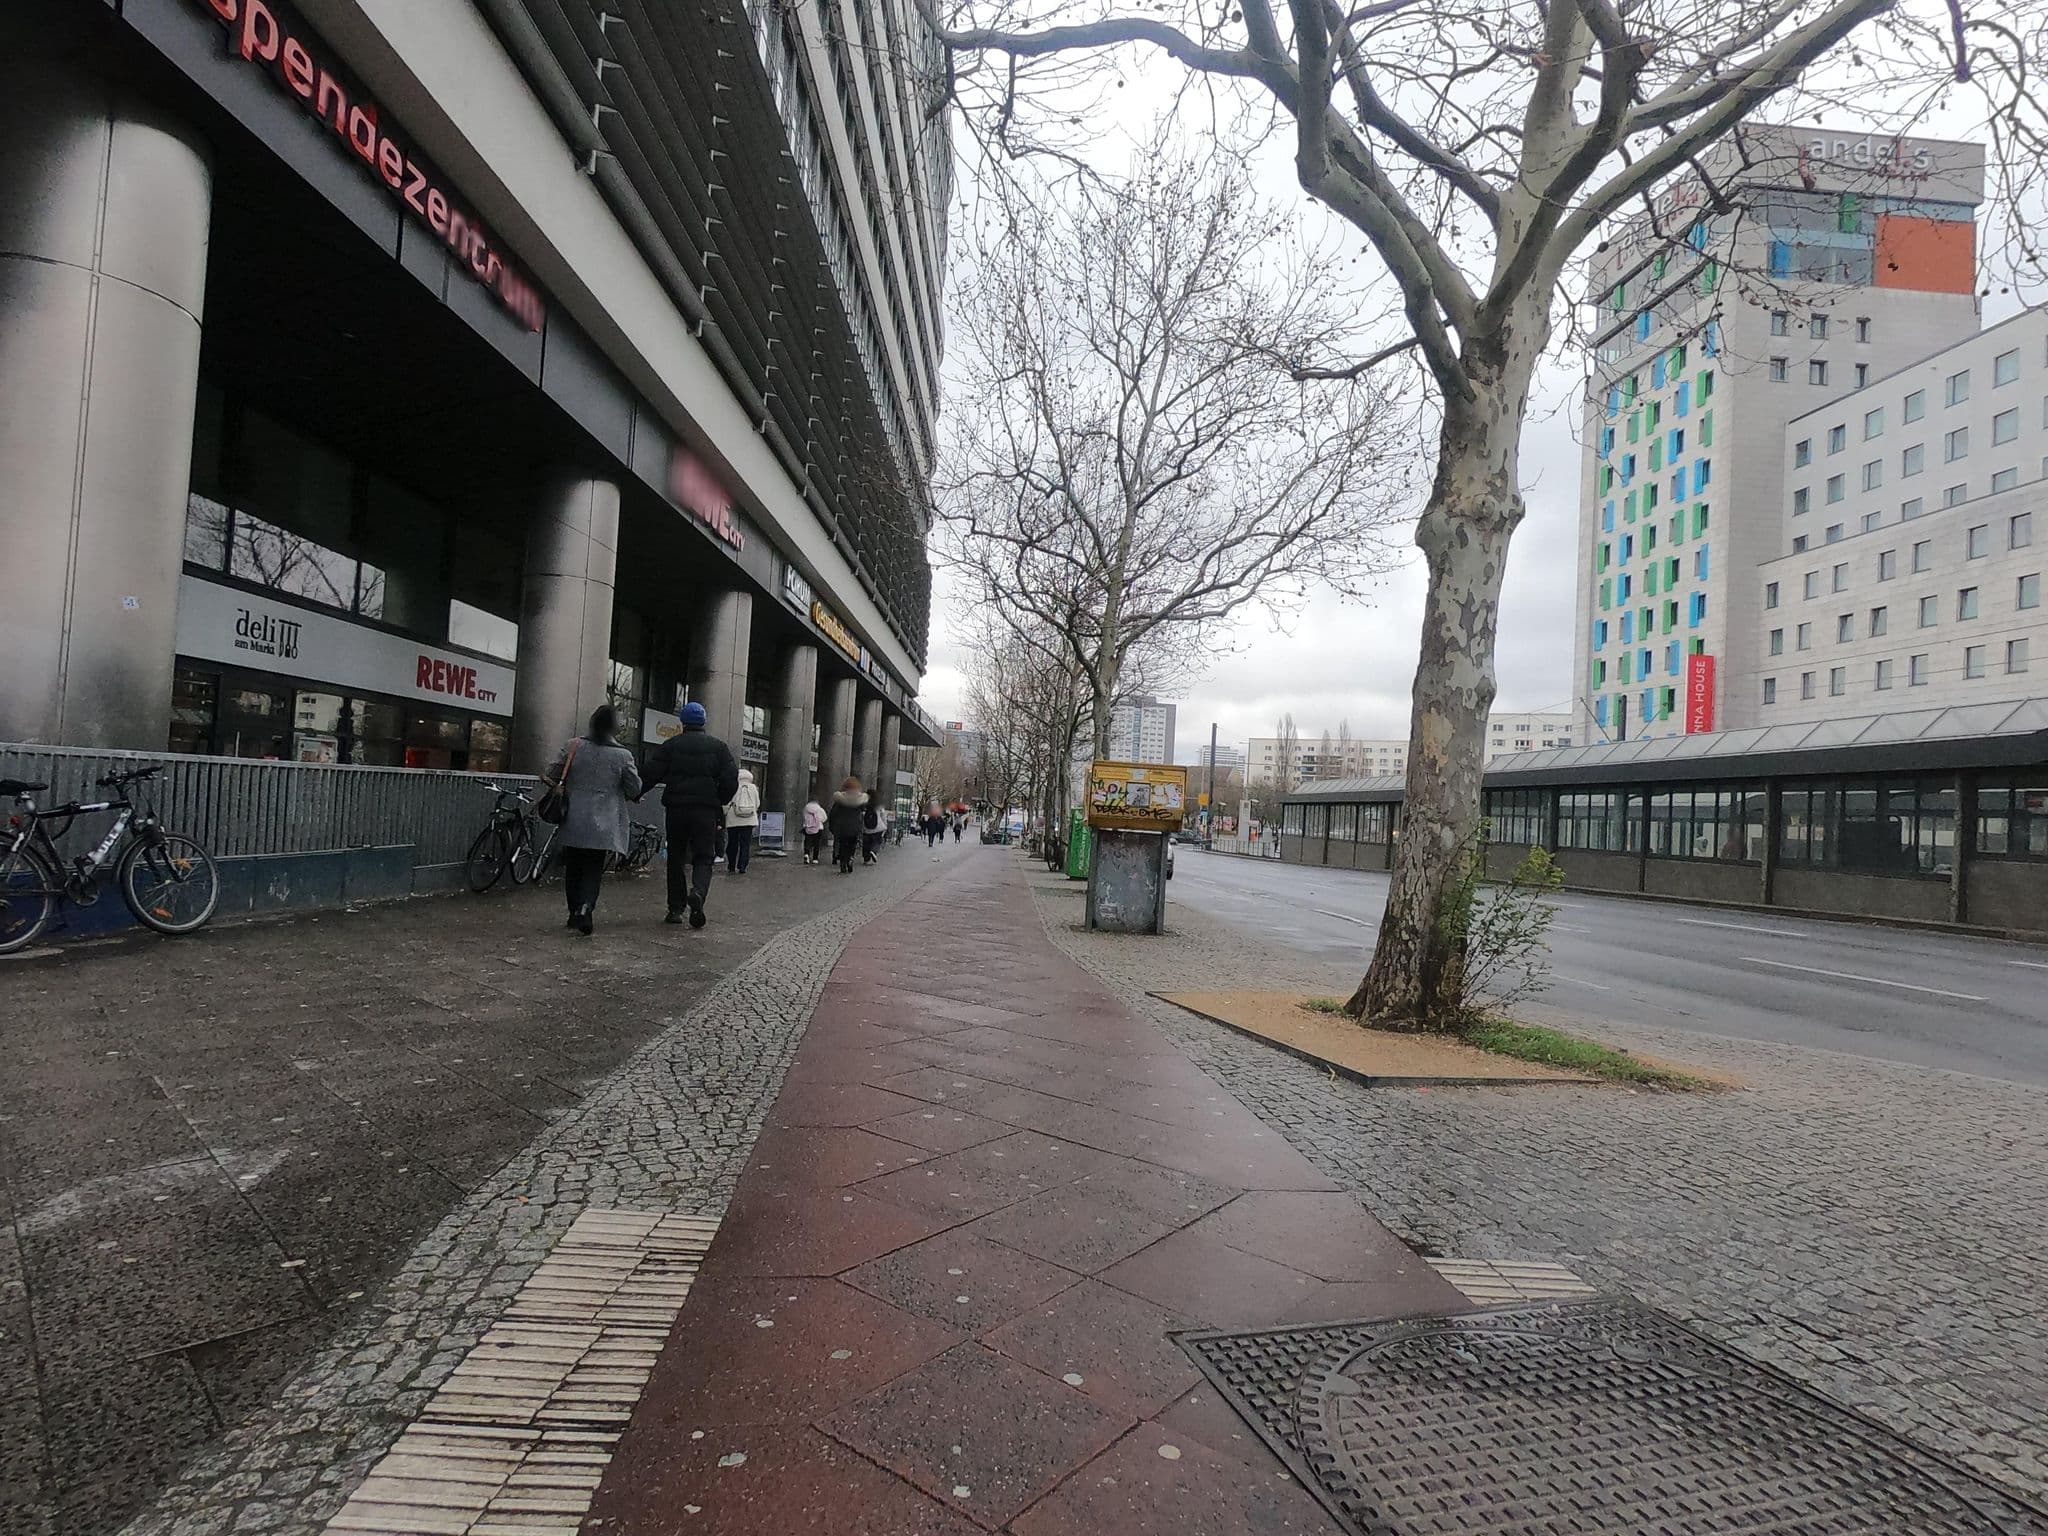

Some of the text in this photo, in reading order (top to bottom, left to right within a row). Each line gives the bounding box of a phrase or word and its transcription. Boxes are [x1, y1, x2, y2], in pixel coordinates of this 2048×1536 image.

[236, 609, 276, 643] deli
[416, 655, 497, 703] REWE CITY
[1694, 660, 1706, 733] NNA HOUSE
